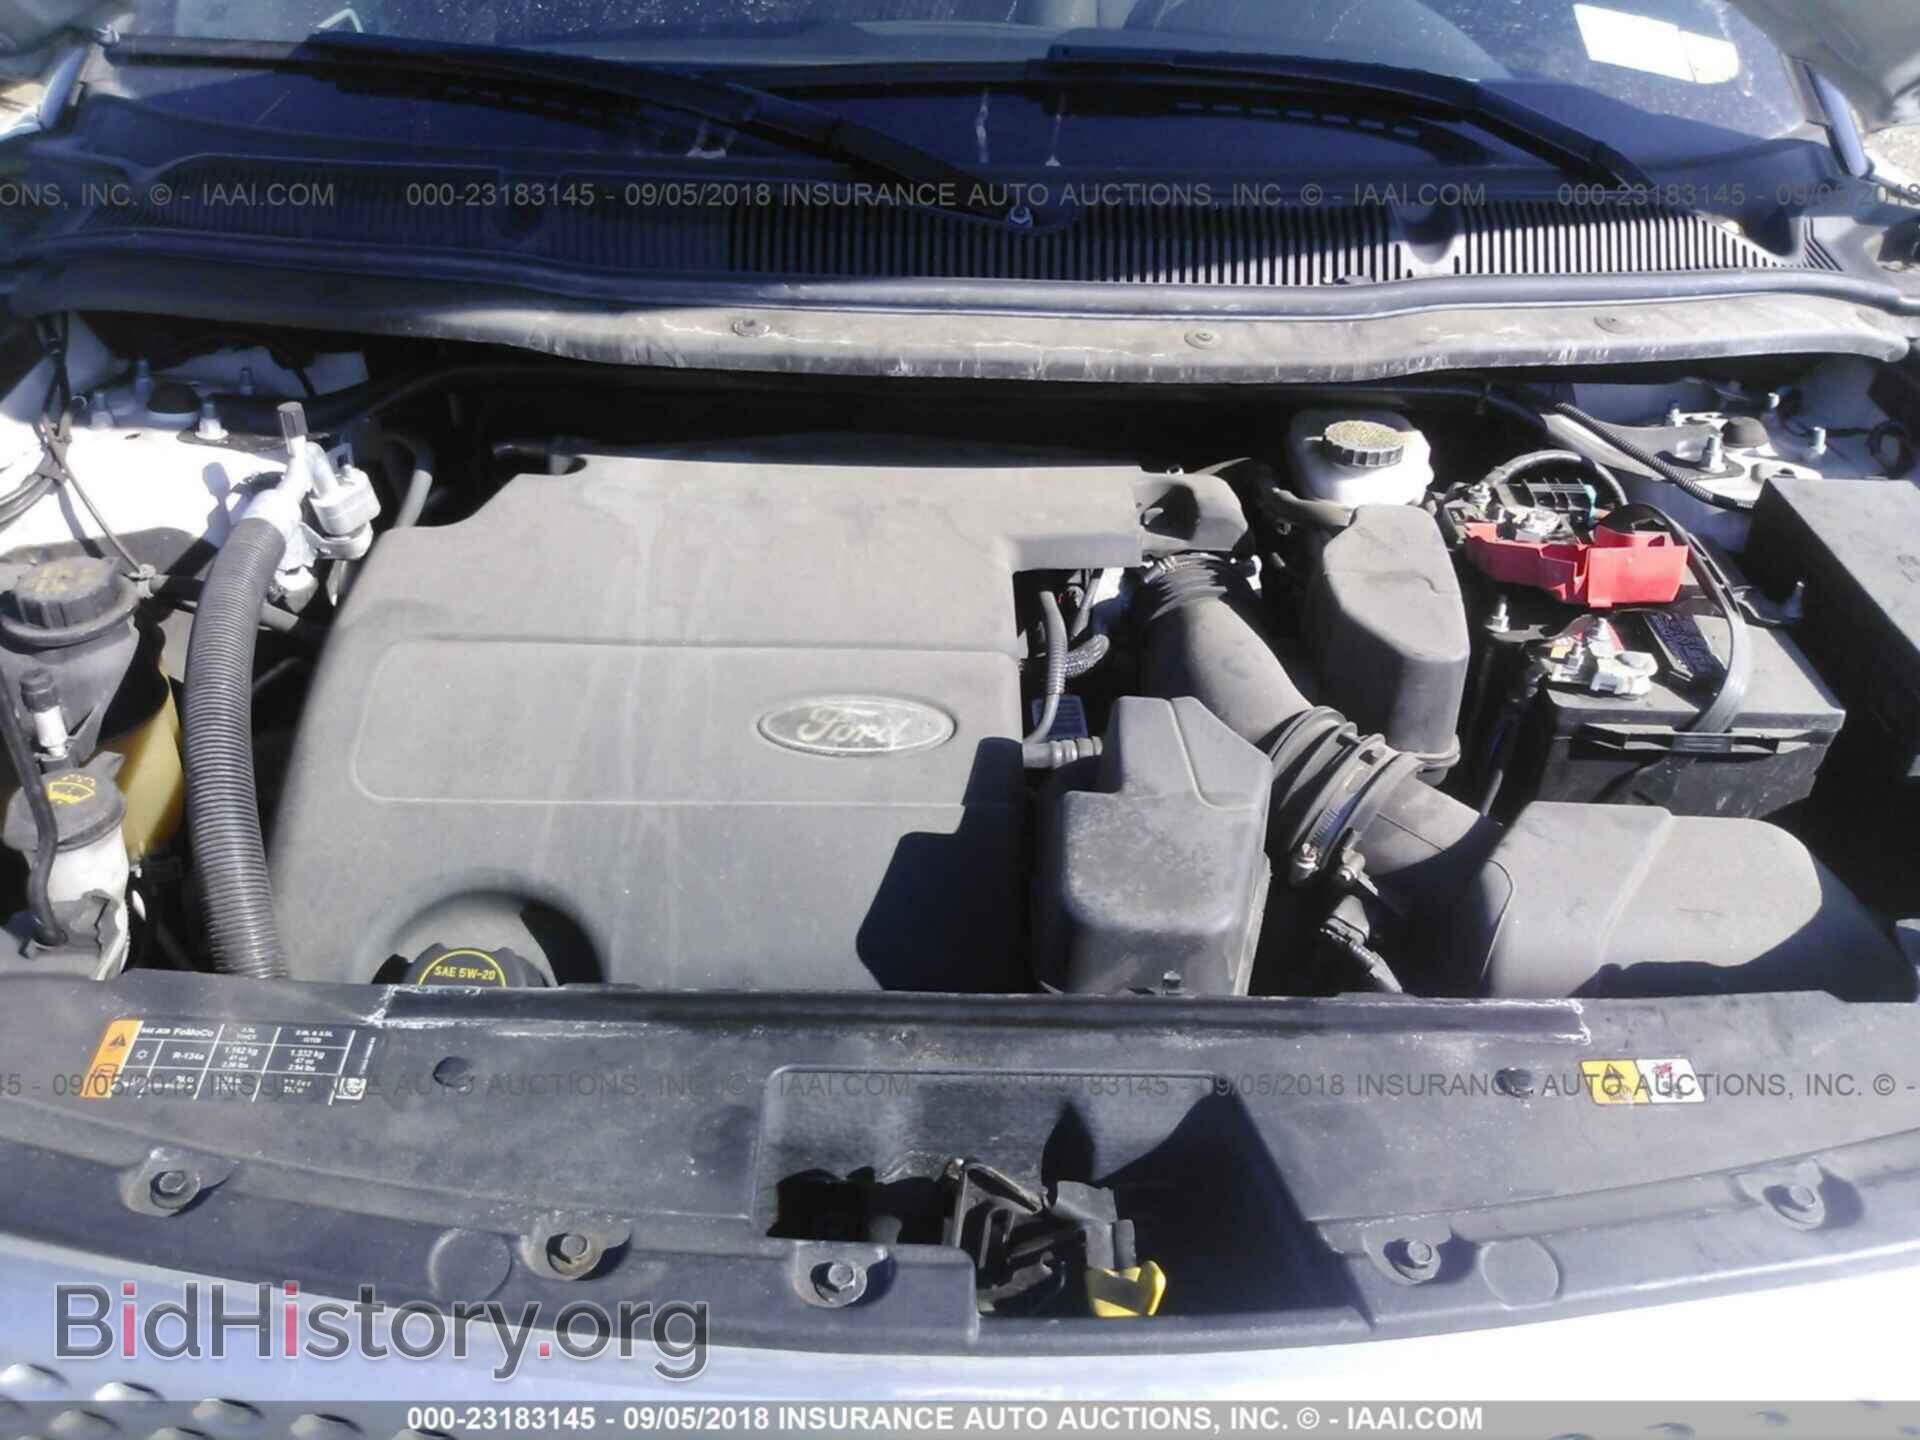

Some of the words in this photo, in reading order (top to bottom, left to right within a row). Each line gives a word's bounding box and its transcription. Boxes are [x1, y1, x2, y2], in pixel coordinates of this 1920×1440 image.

[796, 704, 912, 750] Ford
[432, 965, 457, 978] SAE
[458, 967, 498, 981] 5W-20
